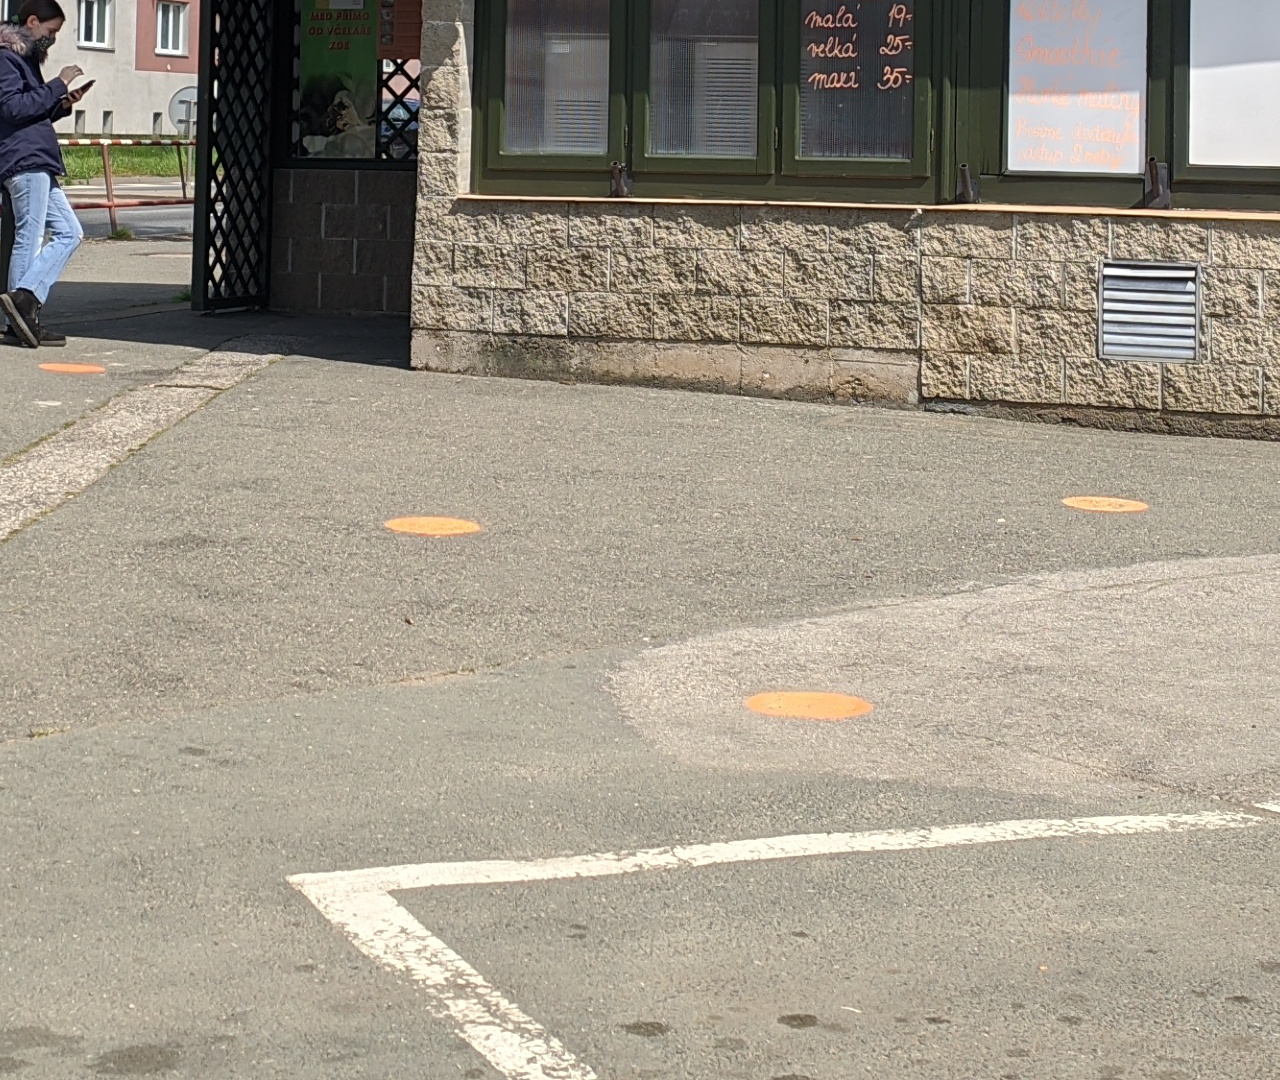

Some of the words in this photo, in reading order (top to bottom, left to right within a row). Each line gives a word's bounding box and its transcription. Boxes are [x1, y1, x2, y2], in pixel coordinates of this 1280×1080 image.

[310, 12, 333, 21] MED
[308, 26, 324, 36] OD
[806, 32, 858, 58] velká
